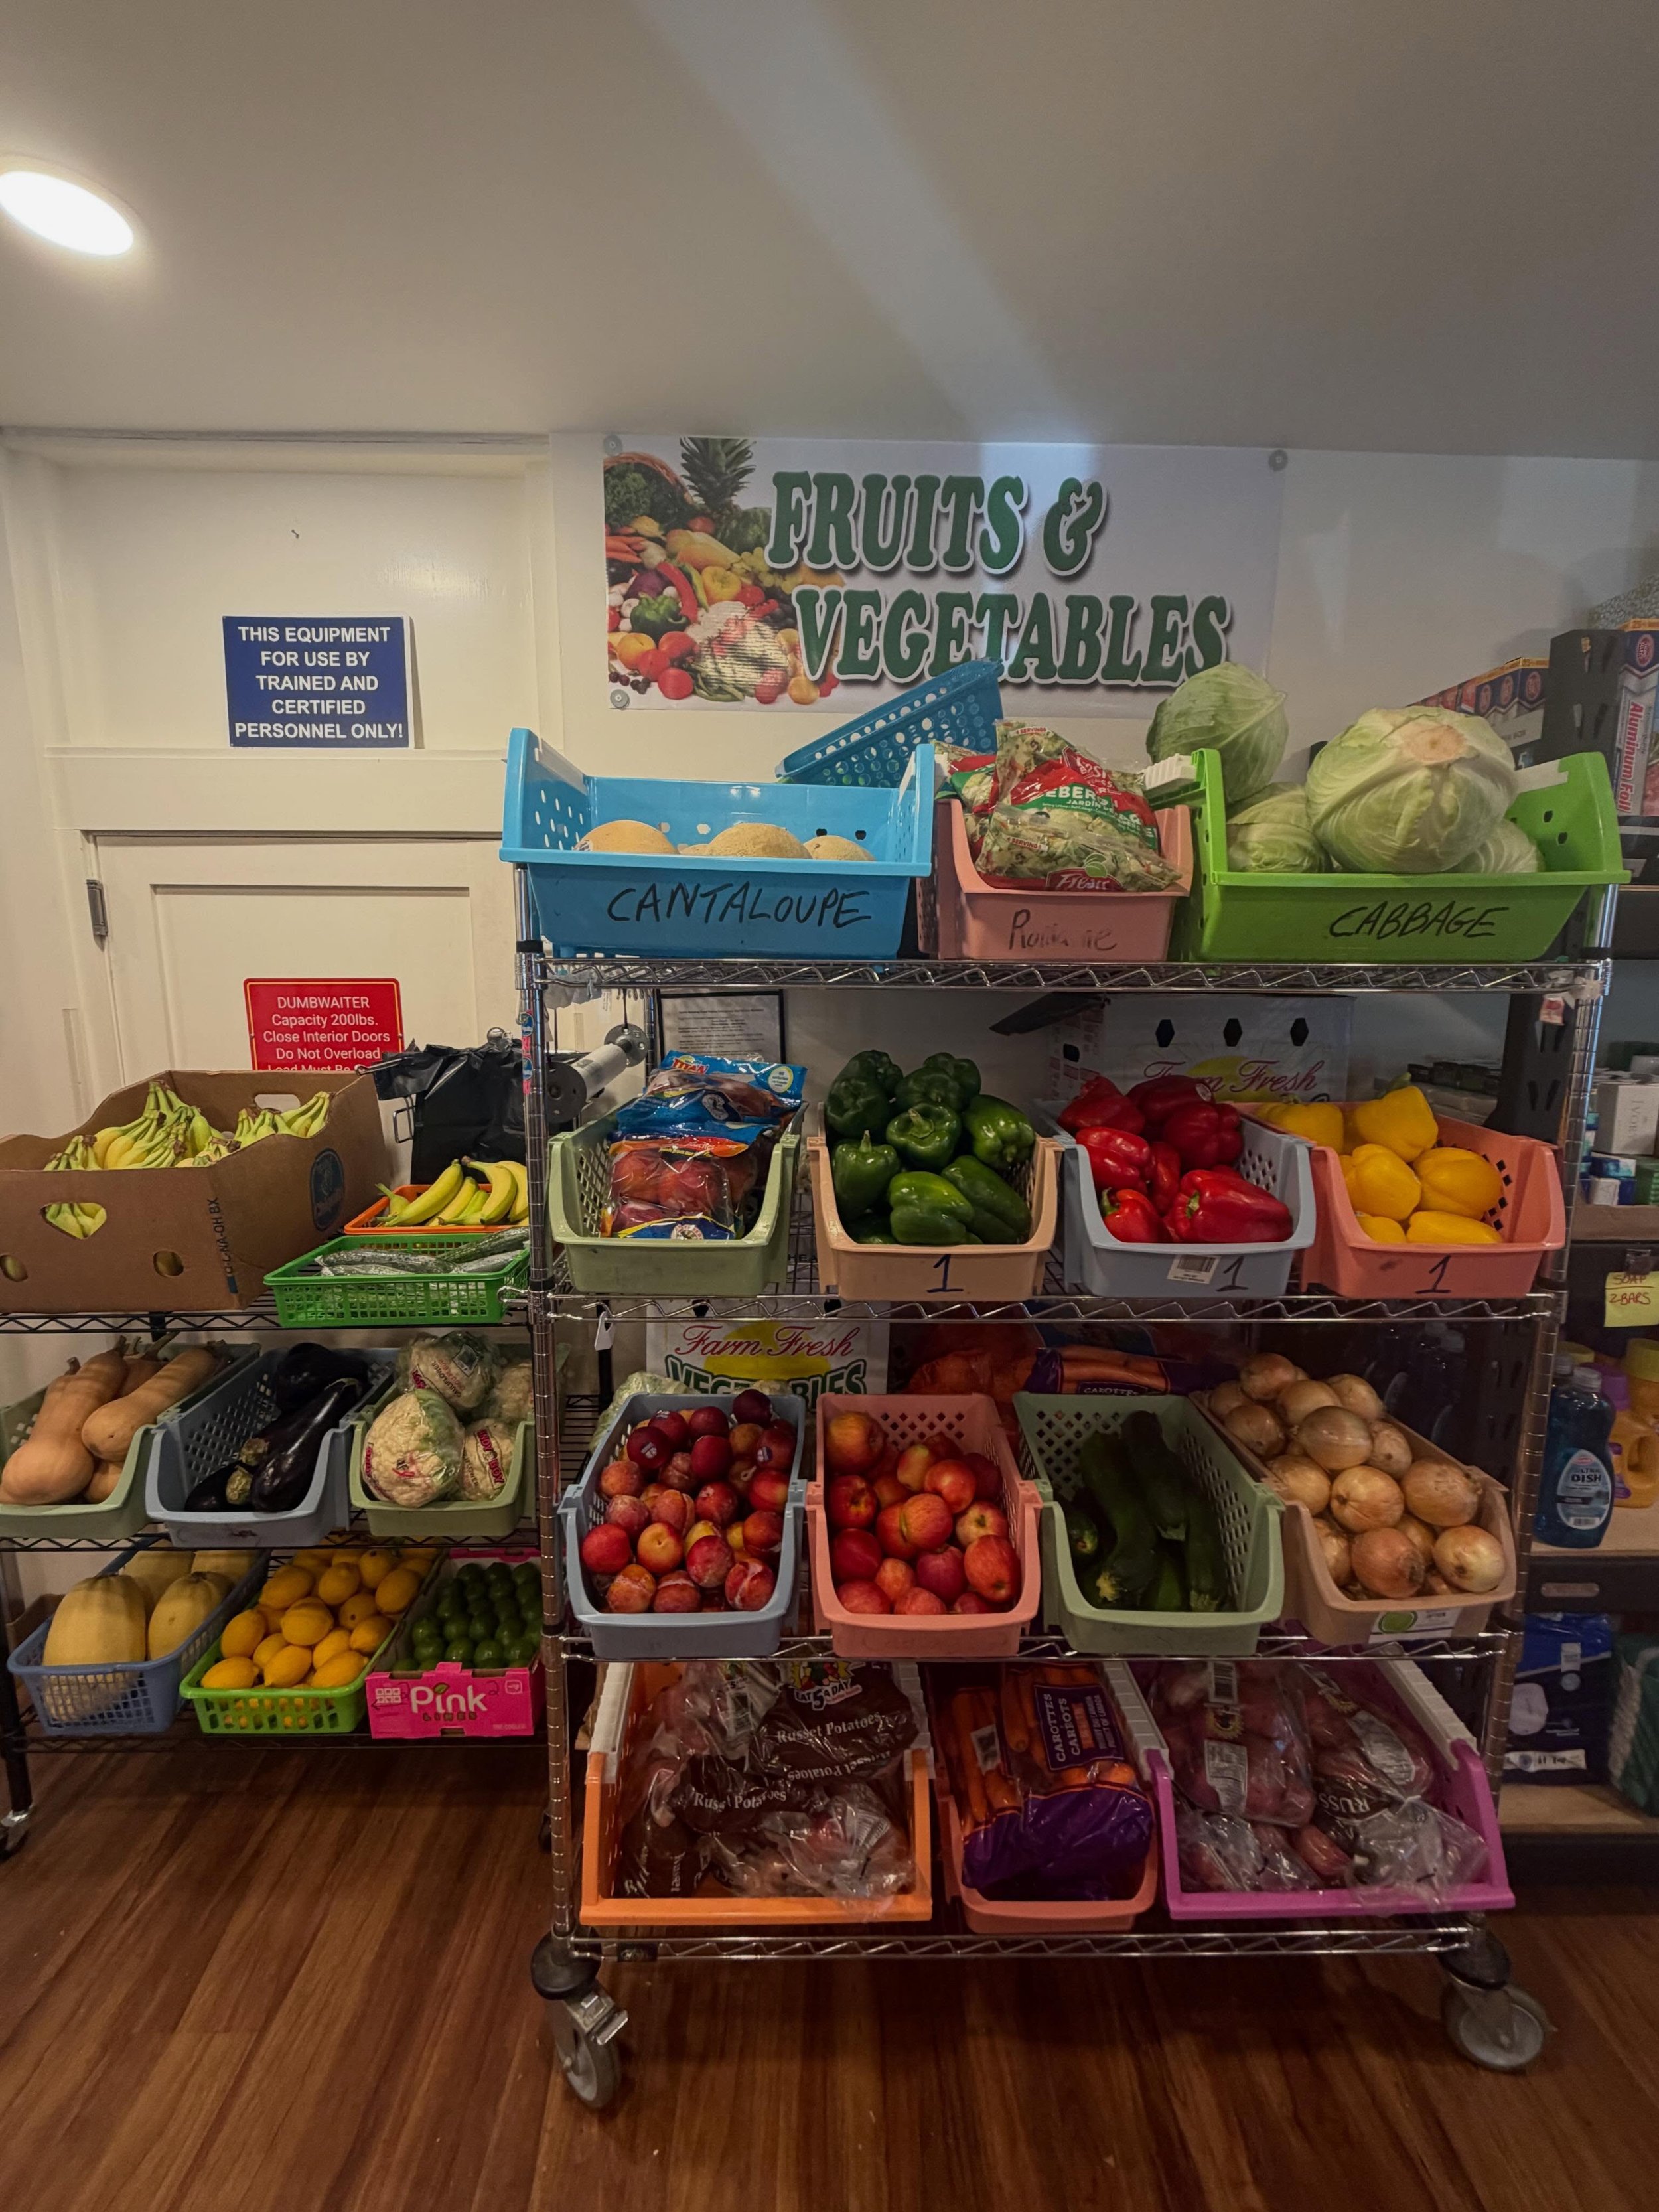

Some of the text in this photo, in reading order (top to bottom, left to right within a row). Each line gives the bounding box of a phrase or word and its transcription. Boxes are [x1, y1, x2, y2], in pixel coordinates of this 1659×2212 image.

[766, 471, 1106, 575] FRUITS &
[238, 627, 390, 643] THIS EQUIPMENT
[792, 585, 1230, 688] VEGETABLES
[261, 651, 370, 666] FOR USE BY
[255, 675, 378, 691] TRAINED AND
[272, 700, 366, 715] CERTIFIED
[235, 723, 403, 739] PERSONNEL ONLY!
[1621, 701, 1646, 782] Aluminum
[607, 881, 871, 928] CANTALOUPE
[1329, 901, 1509, 940] CABBAGE
[277, 997, 370, 1009] DUMBWAITER
[271, 1013, 378, 1029] Capacity 200lbs.
[263, 1030, 390, 1043] Close Interior Doors
[276, 1047, 380, 1059] Do Not Overload
[672, 1058, 709, 1074] TITAN
[1230, 1059, 1326, 1093] Fresh
[206, 1197, 221, 1214] BX
[926, 1254, 964, 1293] 1
[1216, 1254, 1249, 1292] 1
[1415, 1254, 1452, 1294] 1
[1613, 1274, 1647, 1284] SOAP
[674, 1325, 861, 1357] Farm Fresh
[1571, 1473, 1602, 1483] DISH
[409, 1685, 489, 1714] Pink
[814, 1689, 825, 1710] 5
[831, 1679, 853, 1696] DAY
[777, 1713, 881, 1744] Russet Potatoes
[1043, 1692, 1066, 1763] CAROTTES
[1058, 1697, 1082, 1756] CARROTS
[787, 1765, 843, 1781] Potatoes
[693, 1791, 732, 1813] Russt
